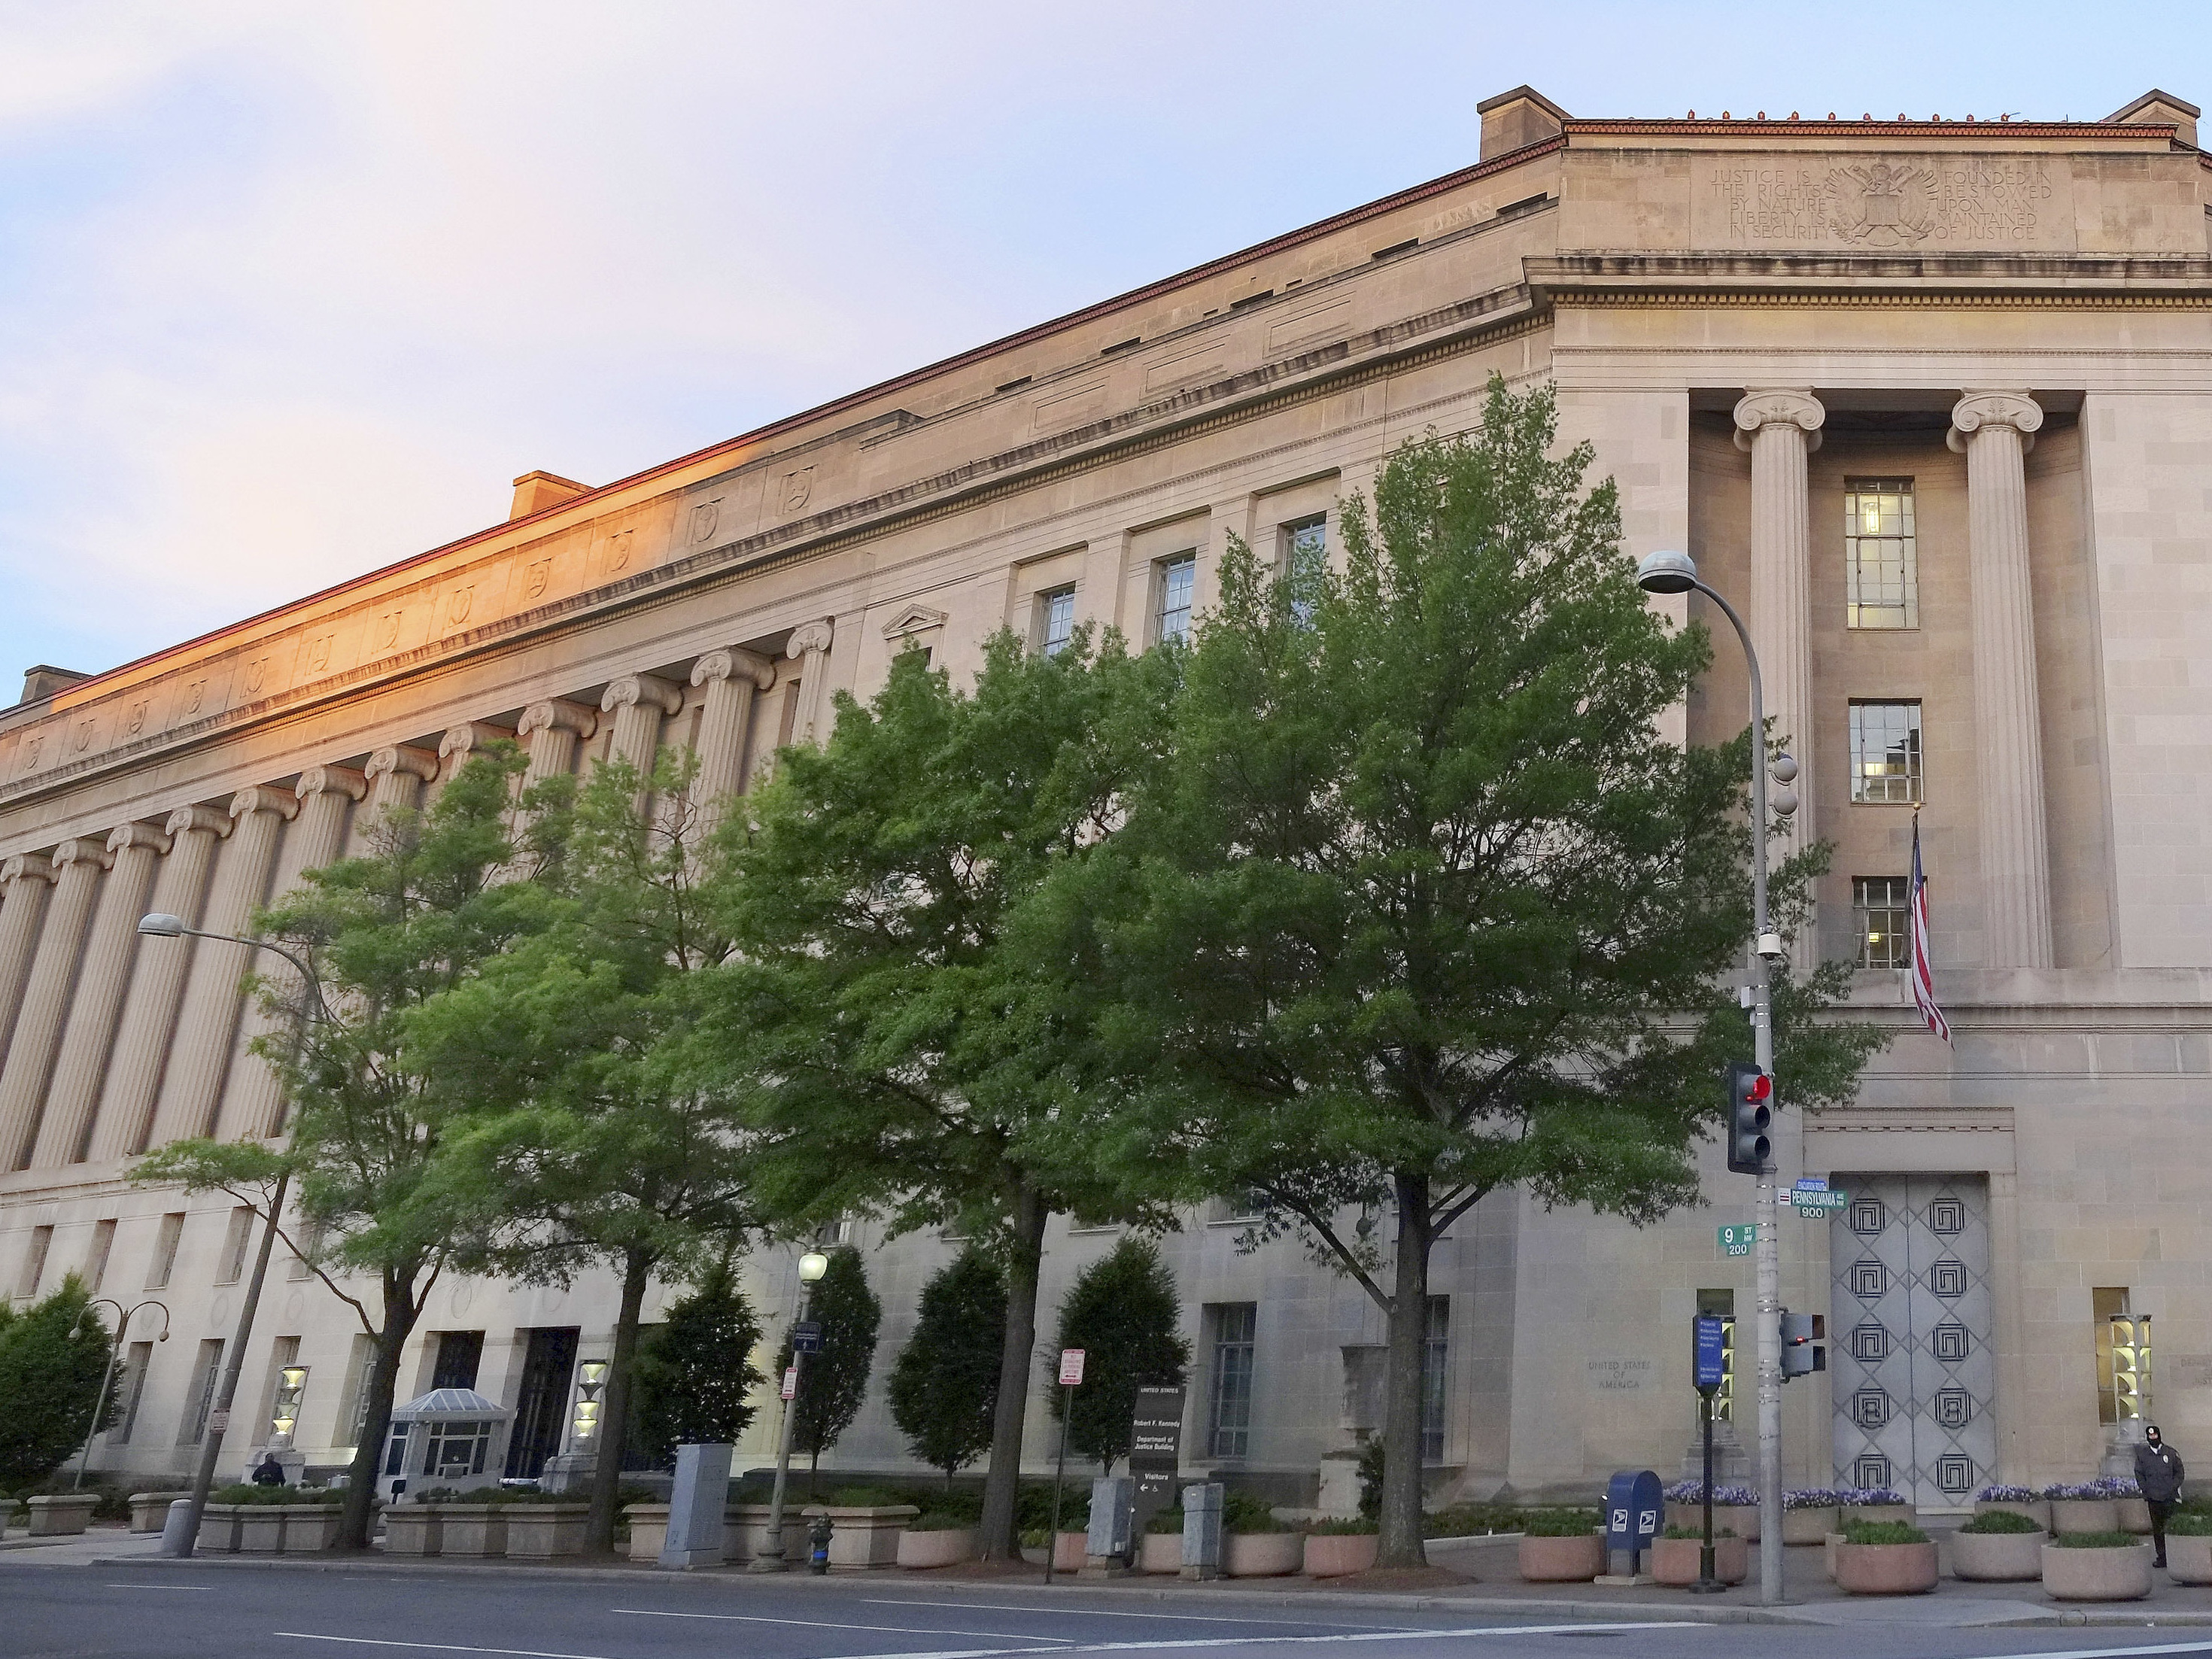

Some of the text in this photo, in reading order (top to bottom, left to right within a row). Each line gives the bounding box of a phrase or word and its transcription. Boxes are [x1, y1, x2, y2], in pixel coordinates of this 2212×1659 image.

[1709, 169, 2052, 185] JUSTICE IS FOUNDED IN
[1711, 184, 2052, 199] THE RIGHTS BESTOWED
[1730, 197, 1749, 211] BY
[1758, 198, 1828, 211] NATURE
[1937, 199, 1984, 212] UPON
[1730, 211, 2037, 226] LIBERTY IS MAINTAINED
[1730, 225, 1745, 239] IN
[1752, 225, 1831, 239] SECURITY
[1934, 226, 1957, 239] OF
[1792, 1190, 1836, 1206] PENNSYLVANIA
[1801, 1207, 1823, 1218] 900
[1724, 1228, 1733, 1243] 9
[1729, 1244, 1747, 1255] 200
[1588, 1360, 1651, 1370] UNITED STATES
[1599, 1380, 1639, 1389] AMERICA
[1159, 1420, 1180, 1428] Kennedy
[1154, 1443, 1174, 1451] Building
